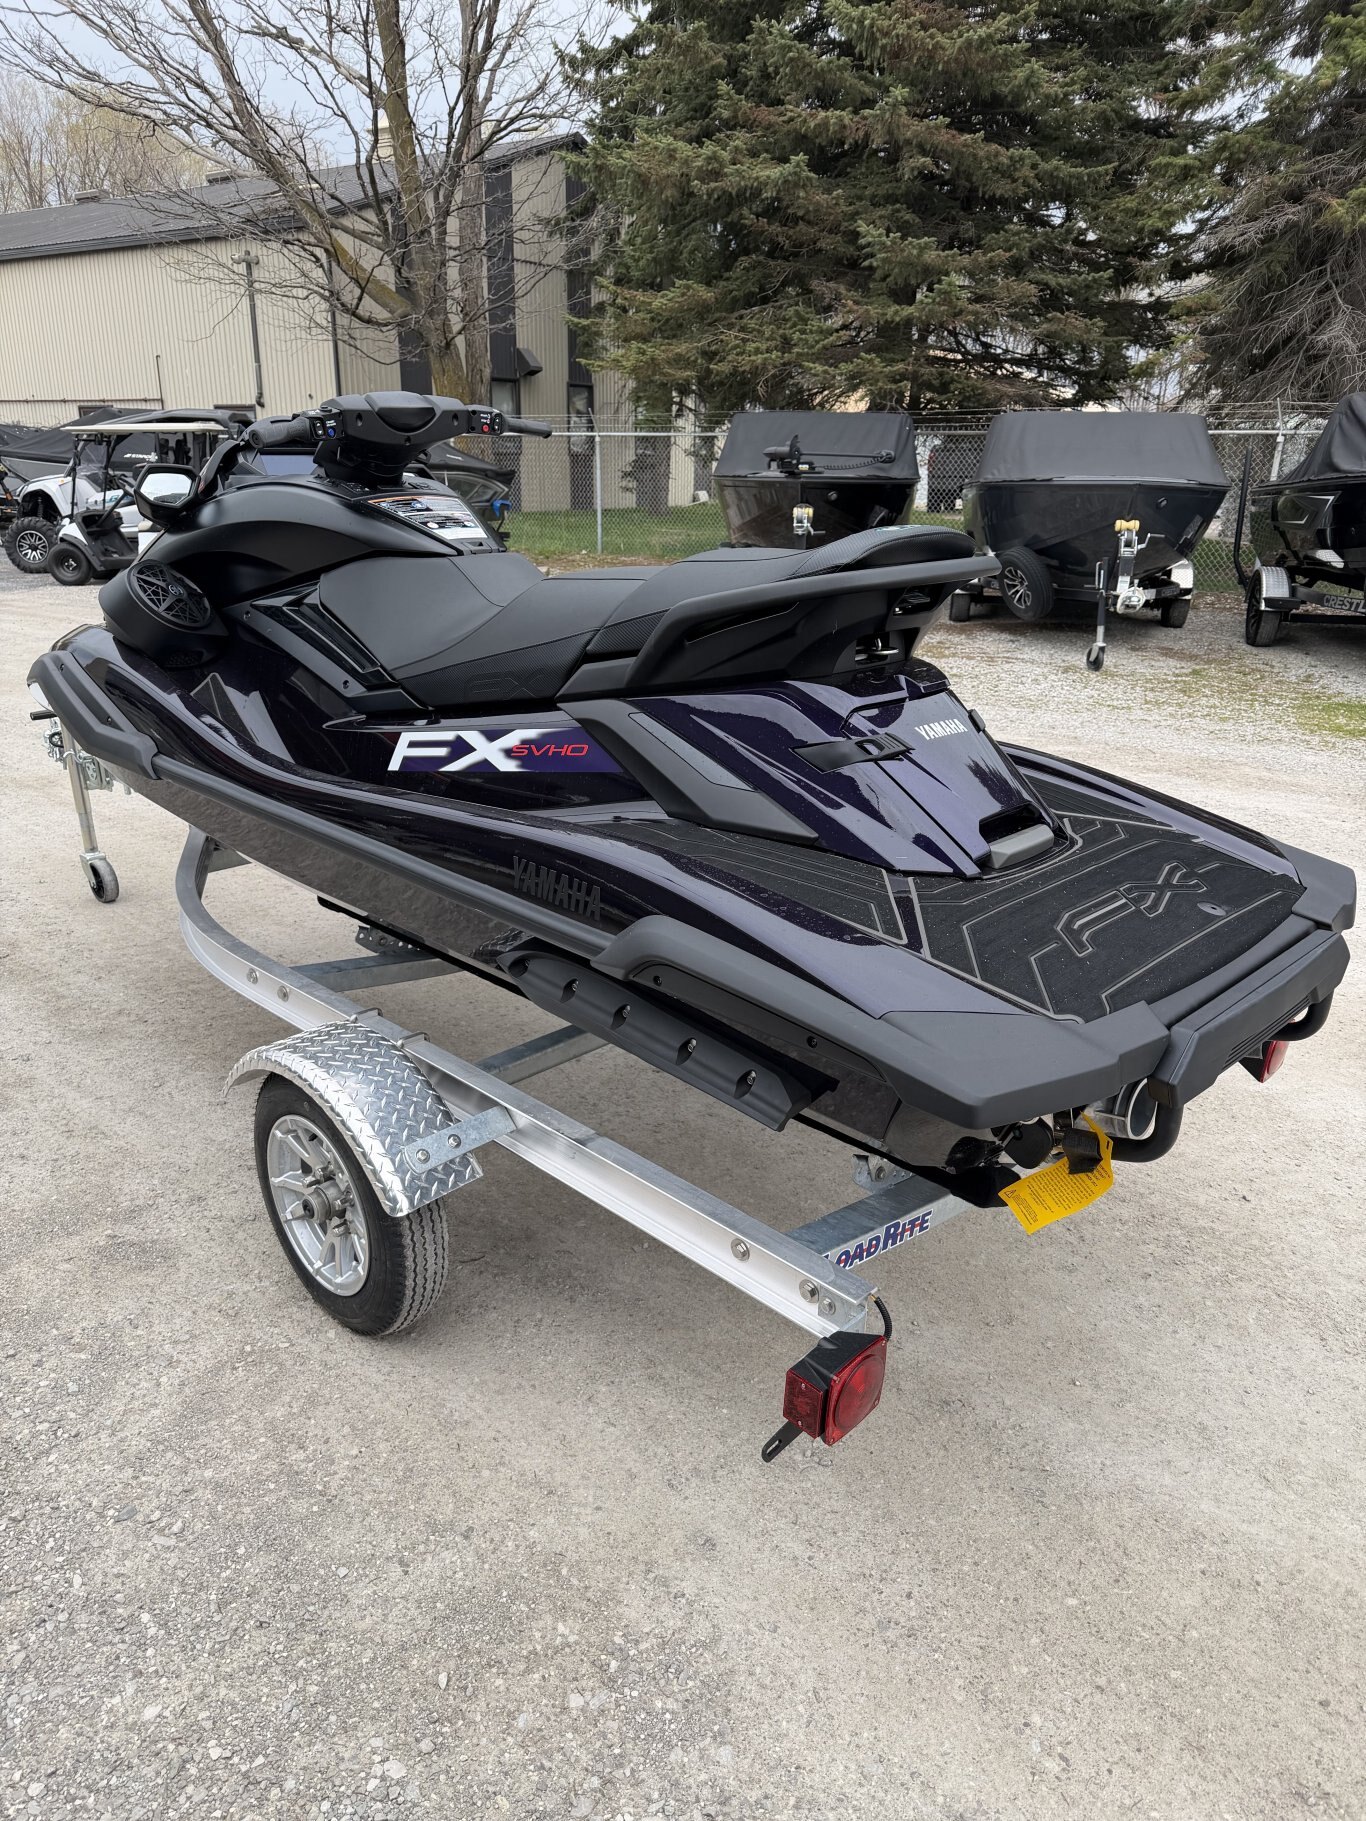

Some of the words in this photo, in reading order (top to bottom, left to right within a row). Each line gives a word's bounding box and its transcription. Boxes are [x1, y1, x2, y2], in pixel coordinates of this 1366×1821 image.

[387, 728, 552, 772] FX
[511, 744, 589, 756] SVHO
[914, 718, 968, 740] YAMAHA
[513, 855, 600, 921] YAMAHA
